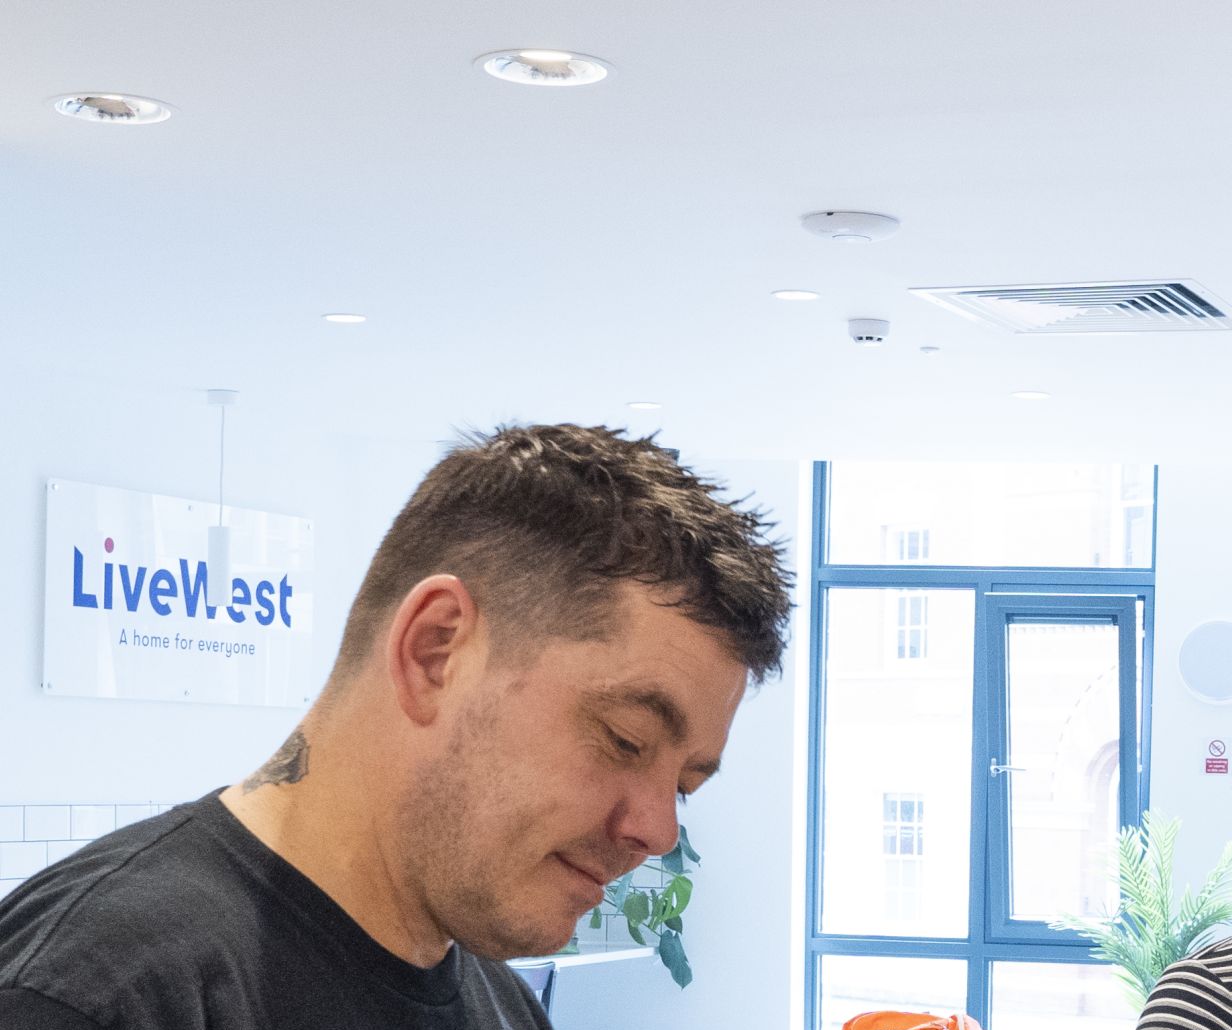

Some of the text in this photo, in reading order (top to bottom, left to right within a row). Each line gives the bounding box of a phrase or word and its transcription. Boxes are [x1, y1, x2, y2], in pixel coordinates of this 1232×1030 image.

[73, 537, 293, 629] LiveWest
[119, 628, 256, 658] A home for everyone
